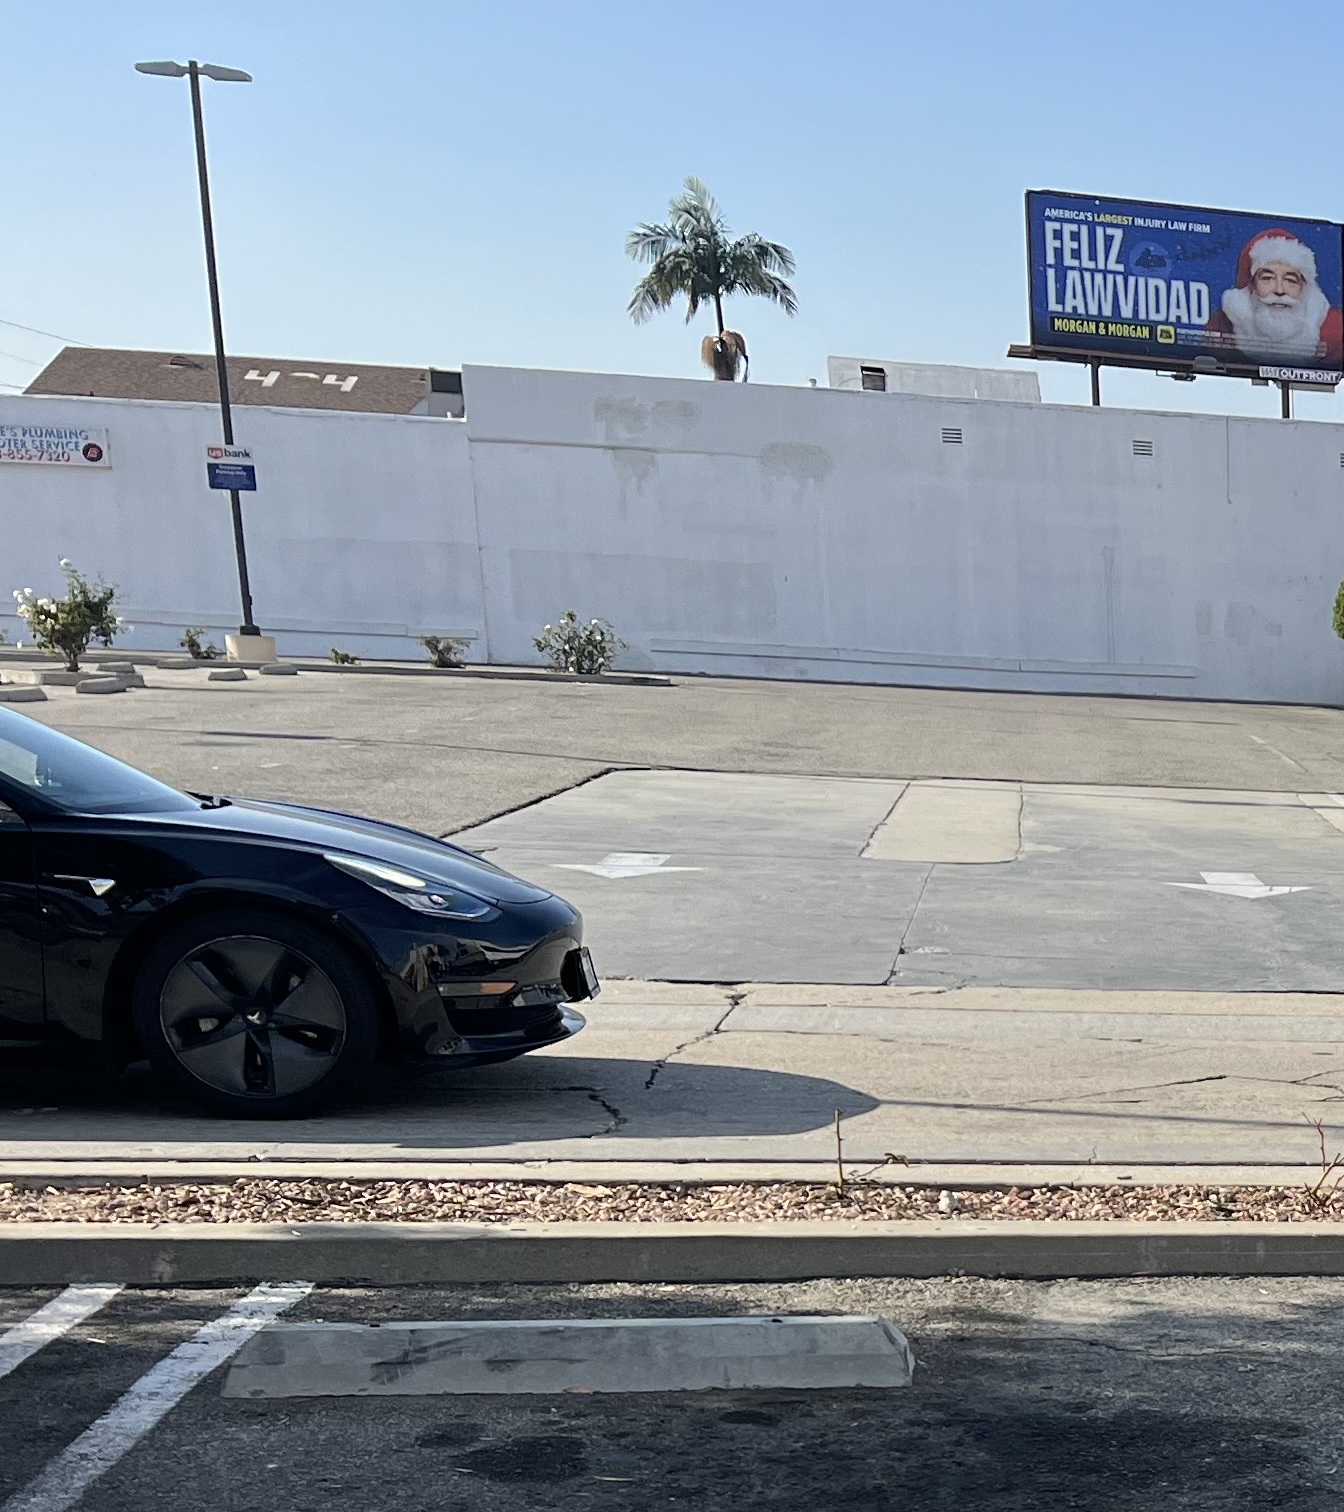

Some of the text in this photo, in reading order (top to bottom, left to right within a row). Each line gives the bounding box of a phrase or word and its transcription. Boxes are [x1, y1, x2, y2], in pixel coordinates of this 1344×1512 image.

[1044, 207, 1211, 234] AMERICA'S LARGEST INJURY LAW FIRM
[1044, 220, 1125, 273] FELIZ
[1046, 267, 1210, 326] LAWVIDAD
[1054, 317, 1150, 340] MORGAN & MORGAN
[1280, 369, 1337, 381] OUTFRONT
[22, 427, 89, 441] PLUMBING
[32, 440, 80, 452] SERVICE
